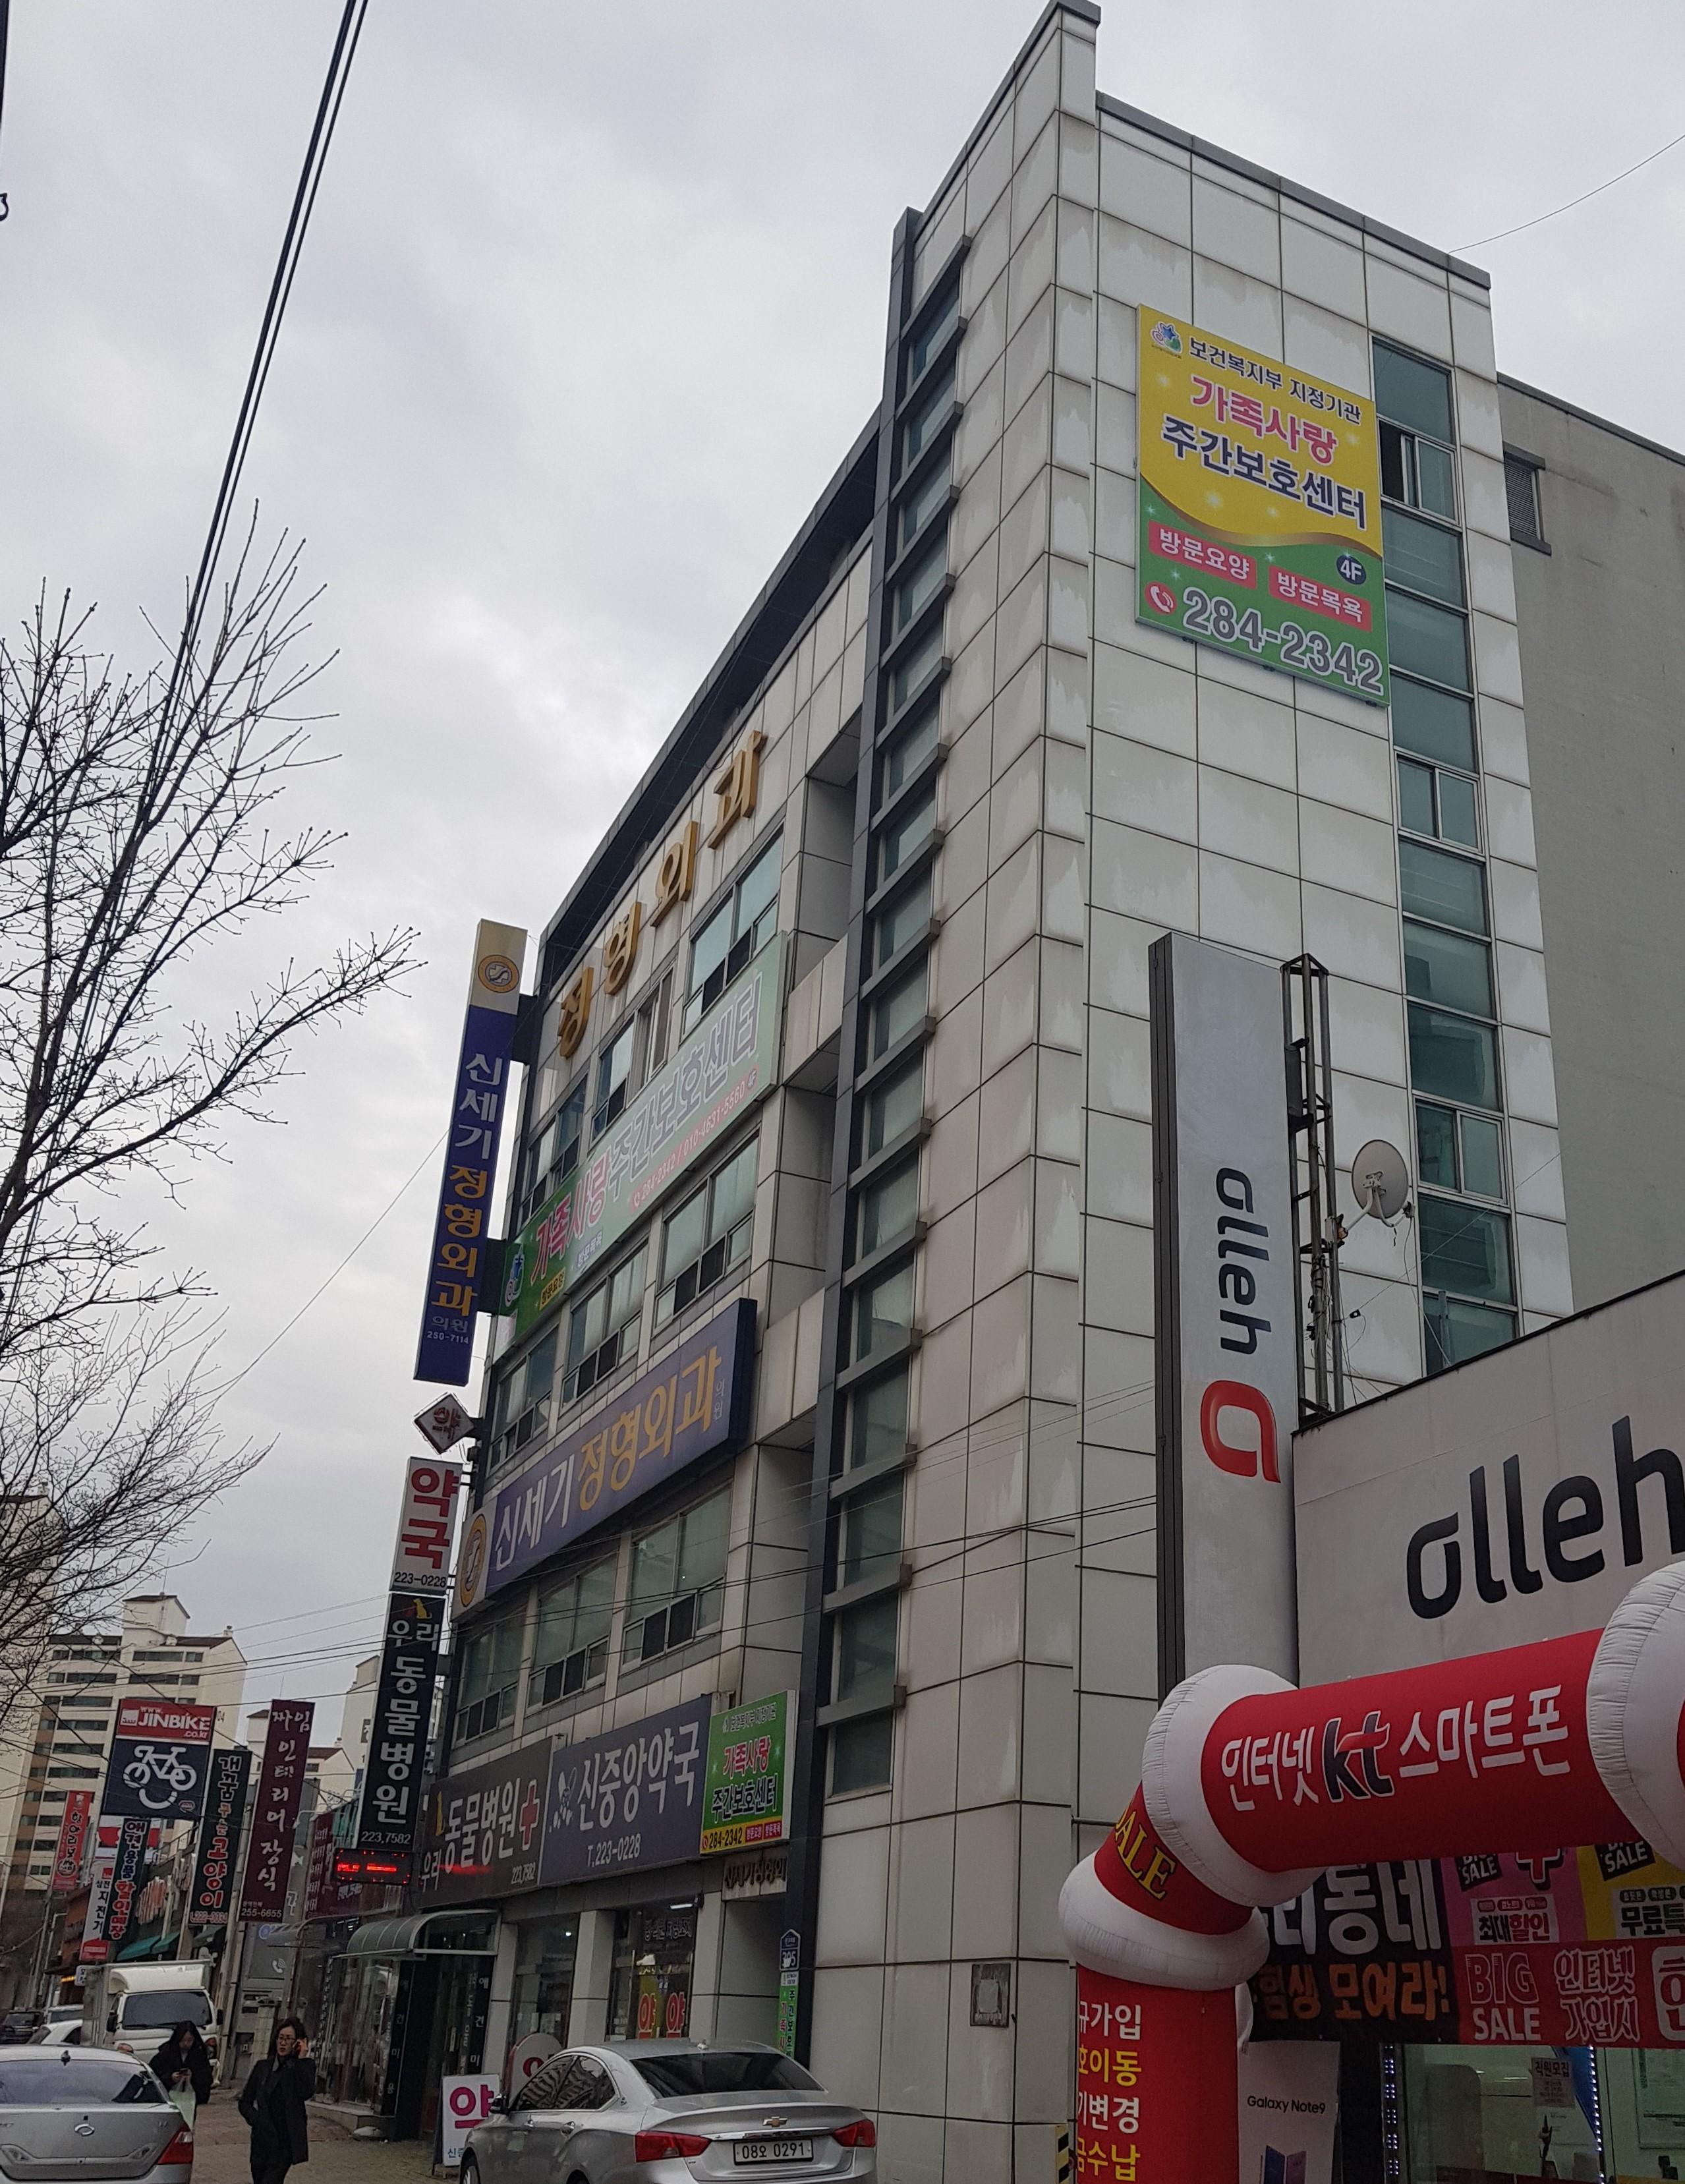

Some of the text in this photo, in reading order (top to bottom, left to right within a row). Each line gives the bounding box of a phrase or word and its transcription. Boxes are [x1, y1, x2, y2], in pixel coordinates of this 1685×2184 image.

[1189, 337, 1361, 425] 보건복지부 지정기관
[1190, 374, 1338, 467] 가족사랑
[1162, 415, 1367, 531] 주간보호센터
[1159, 528, 1249, 581] 방문요양
[1340, 558, 1362, 580] 4F
[1277, 571, 1363, 623] 방문목욕
[1183, 587, 1384, 695] 284-2342
[455, 1053, 503, 1160] 신세기
[530, 972, 762, 1286] 가족사랑 주간보호센터
[432, 1164, 488, 1317] 정형외과
[427, 1331, 469, 1344] 250-7114
[432, 1316, 468, 1333] 의원
[496, 1346, 722, 1571] 신세기 정형외과
[401, 1468, 459, 1569] 약국
[395, 1572, 447, 1588] 223-0228
[387, 1619, 440, 1651] 우리
[138, 1713, 211, 1731] JINBIKE
[372, 1655, 426, 1824] 동물병원
[1221, 1725, 1319, 1811] 인터넷
[1398, 1684, 1572, 1779] 스마트폰
[577, 1721, 701, 1832] 신중앙약국
[723, 1735, 771, 1779] 가족사랑
[445, 1777, 522, 1872] 동물병원
[711, 1773, 778, 1824] 주간보호센터
[121, 1821, 146, 1880] 애견용품
[709, 1827, 743, 1849] 284-2342
[1604, 1841, 1648, 1873] SALE
[200, 1837, 229, 1908] 고양이
[258, 1839, 283, 1891] 장식
[419, 1847, 440, 1893] 우리
[1462, 1857, 1497, 1885] SALE
[1329, 1960, 1449, 2021] 모여라!
[1466, 1952, 1539, 2004] BIG
[1554, 1945, 1635, 1995] 인터넷
[1473, 2007, 1541, 2041] SALE
[1247, 2096, 1326, 2115] Galaxy Note9
[741, 2142, 805, 2160] 08오 0291
